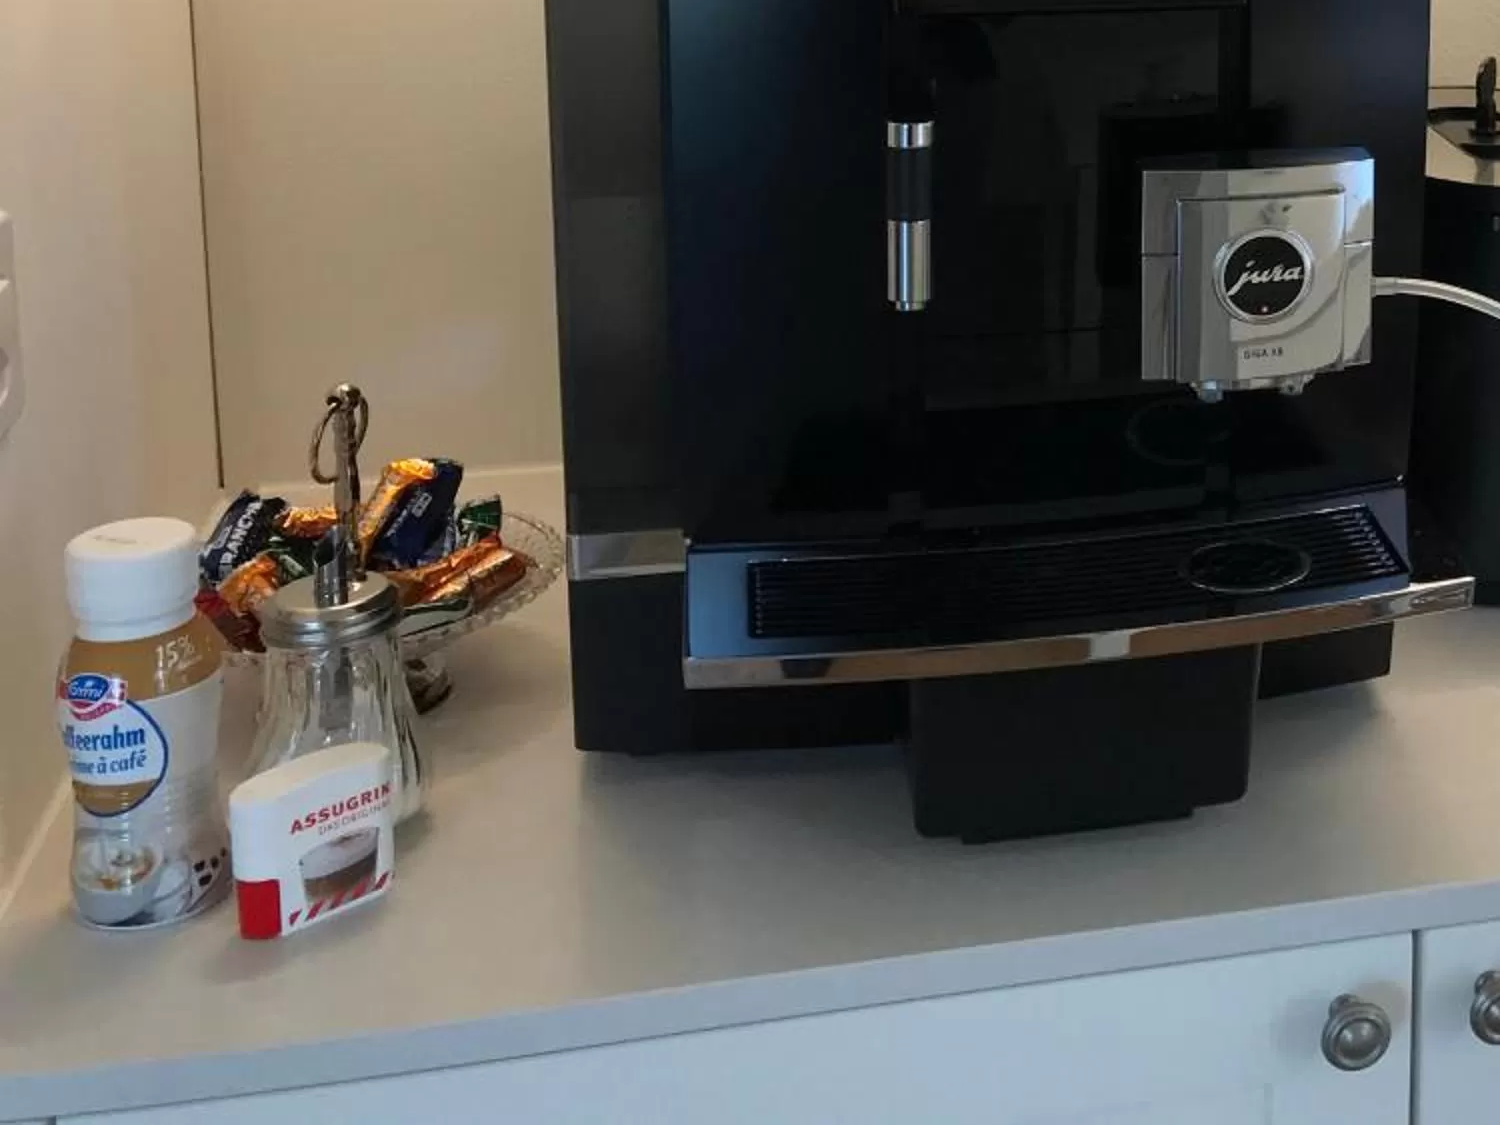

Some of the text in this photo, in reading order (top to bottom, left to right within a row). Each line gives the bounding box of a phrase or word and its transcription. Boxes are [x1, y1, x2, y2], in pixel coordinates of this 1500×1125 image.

[1227, 260, 1302, 297] jura
[155, 635, 196, 668] 15%
[110, 749, 147, 772] café
